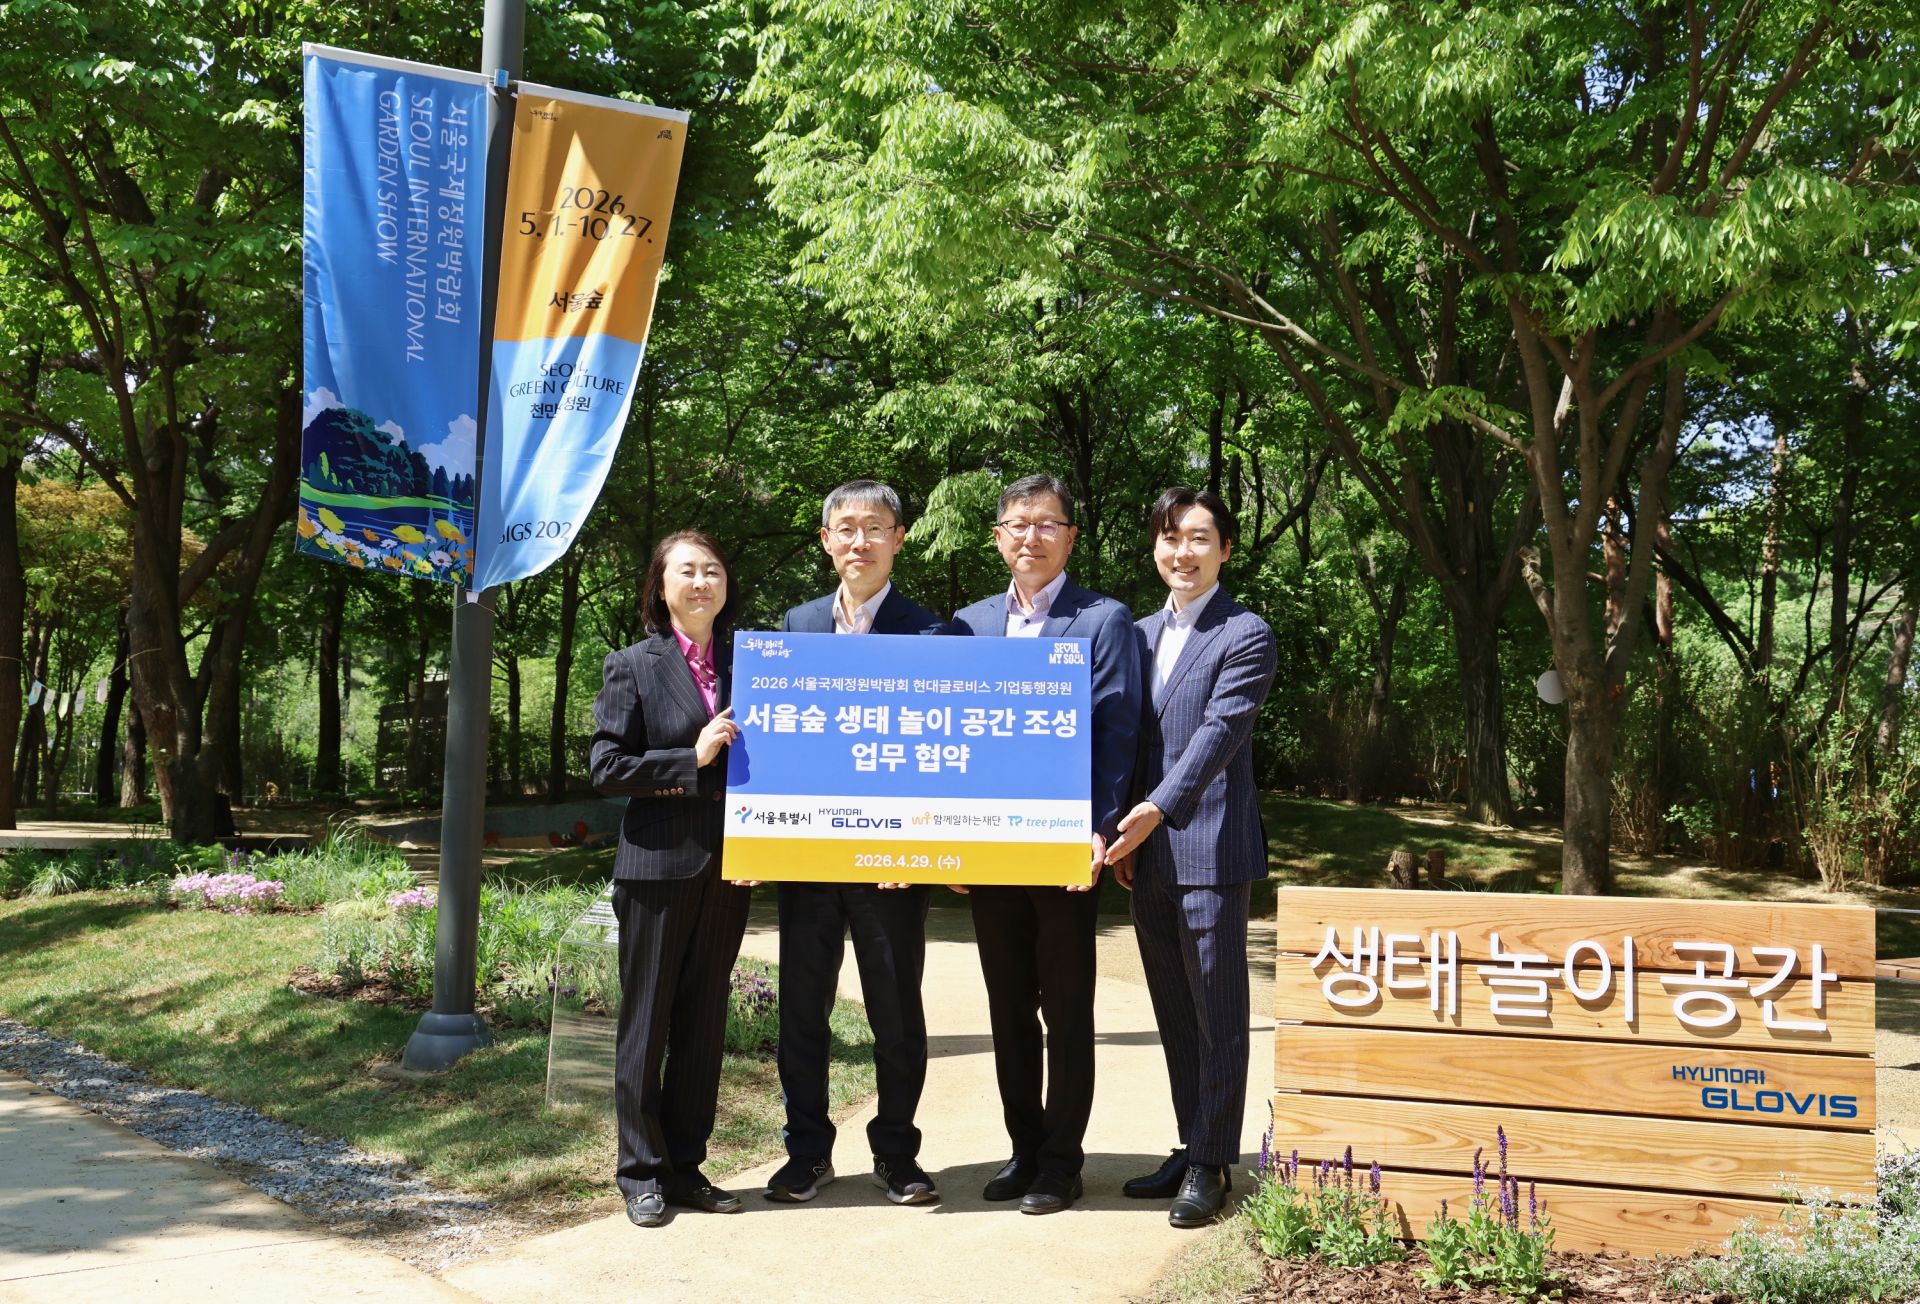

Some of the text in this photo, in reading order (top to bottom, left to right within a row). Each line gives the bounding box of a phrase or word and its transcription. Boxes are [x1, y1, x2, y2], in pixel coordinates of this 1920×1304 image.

[376, 90, 401, 265] GARDEN SHOW
[559, 187, 626, 216] 2026
[434, 102, 468, 324] 서울국제정원박람회
[405, 95, 433, 363] SEOUL INTERNATIONAL
[548, 289, 604, 314] 서울숲
[540, 360, 588, 378] SEOL,
[509, 374, 625, 398] GREEN CLTURE
[530, 396, 591, 419] 천만 정원
[535, 520, 573, 540] 202
[1054, 642, 1080, 654] SEOUL
[1063, 653, 1085, 665] SOUL
[751, 676, 1073, 696] 2026 서울국제정원박람회 현대글로비스 기업동행정원
[743, 703, 1077, 738] 서울숲 생태 놀이 공간 조성
[851, 742, 970, 773] 업무 협약
[754, 811, 811, 825] 서울특별시
[818, 808, 862, 816] HYUNDAI
[933, 814, 1001, 827] 함께일하는재단
[831, 817, 902, 829] GLOVIS
[1026, 818, 1047, 828] tree
[1049, 817, 1084, 830] planet
[854, 853, 961, 871] 2026.4.29. (수)
[1310, 926, 1838, 1032] 생태 놀이 공간
[1672, 1065, 1765, 1085] HYUNDAI
[1701, 1087, 1858, 1119] GLOVIS
